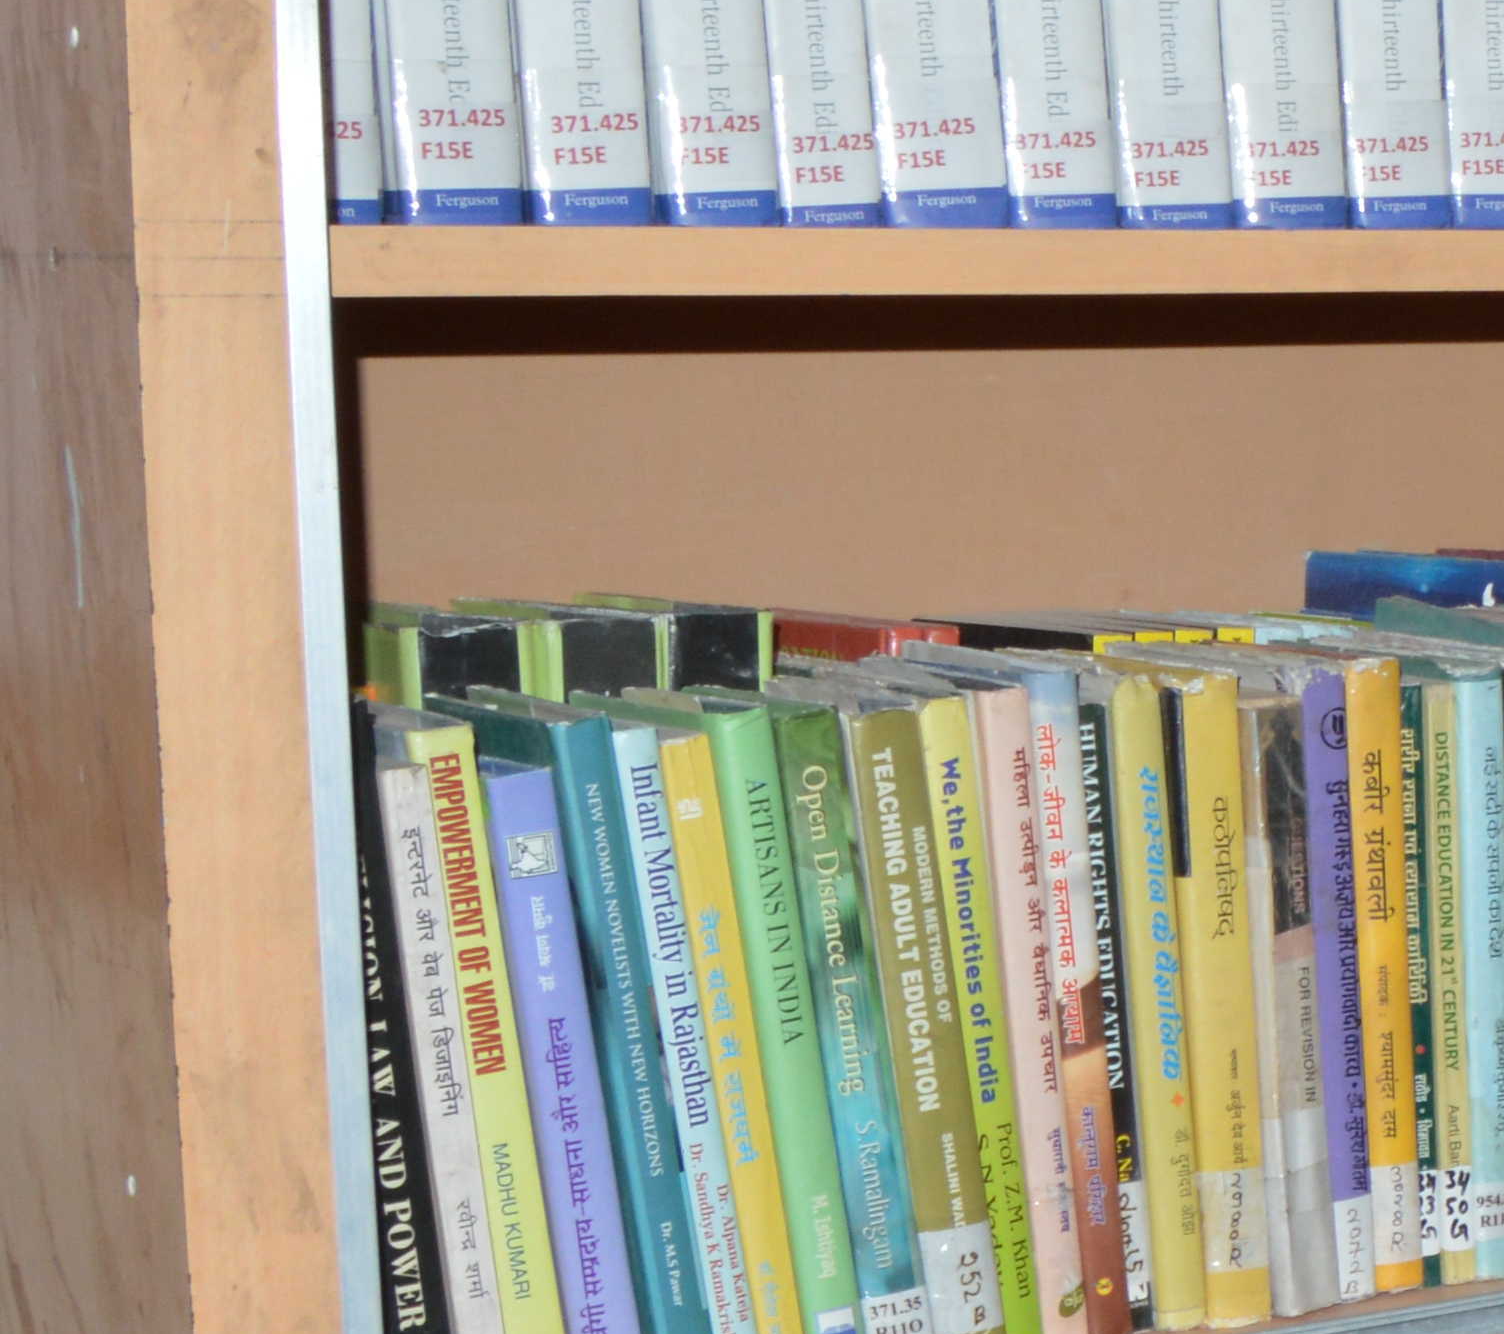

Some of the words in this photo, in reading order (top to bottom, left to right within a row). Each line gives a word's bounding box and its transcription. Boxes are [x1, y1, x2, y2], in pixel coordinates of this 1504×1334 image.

[418, 108, 506, 128] 371.425
[421, 141, 474, 160] F15E
[436, 193, 500, 208] Ferguson
[1152, 207, 1208, 222] Ferguson
[631, 763, 666, 842] Infant
[1079, 723, 1103, 819] HUMAN
[1434, 731, 1451, 812] DISTANCE
[429, 753, 486, 940] EMPOWERMENT
[746, 778, 788, 918] ARTISANS
[872, 747, 901, 877] TEACHING
[645, 845, 687, 965] Mortality
[912, 826, 937, 905] MODERN
[1088, 832, 1111, 931] RIGHTS
[1436, 815, 1455, 934] EDUCATION
[458, 946, 492, 973] OF
[768, 924, 791, 953] IN
[796, 765, 828, 842] Open
[813, 850, 845, 967] Distance
[832, 975, 871, 1096] Learning
[888, 881, 920, 963] ADULT
[922, 906, 947, 997] METHODS
[951, 856, 985, 995] Minorities
[1442, 938, 1455, 951] IN
[665, 970, 695, 997] in
[773, 962, 804, 1045] INDIA
[936, 1000, 952, 1024] OF
[969, 1002, 992, 1029] of
[1097, 933, 1124, 1090] EDUCATION
[463, 980, 506, 1077] WOMEN
[666, 1005, 713, 1128] Rajasthan
[901, 969, 941, 1113] EDUCATION
[1442, 989, 1460, 1072] CENTURY
[969, 1035, 996, 1105] India
[375, 1118, 408, 1190] AND
[492, 1143, 518, 1216] MADHU
[383, 1197, 426, 1332] POWER
[504, 1223, 531, 1300] KUMARI
[868, 1297, 922, 1320] 371.35
